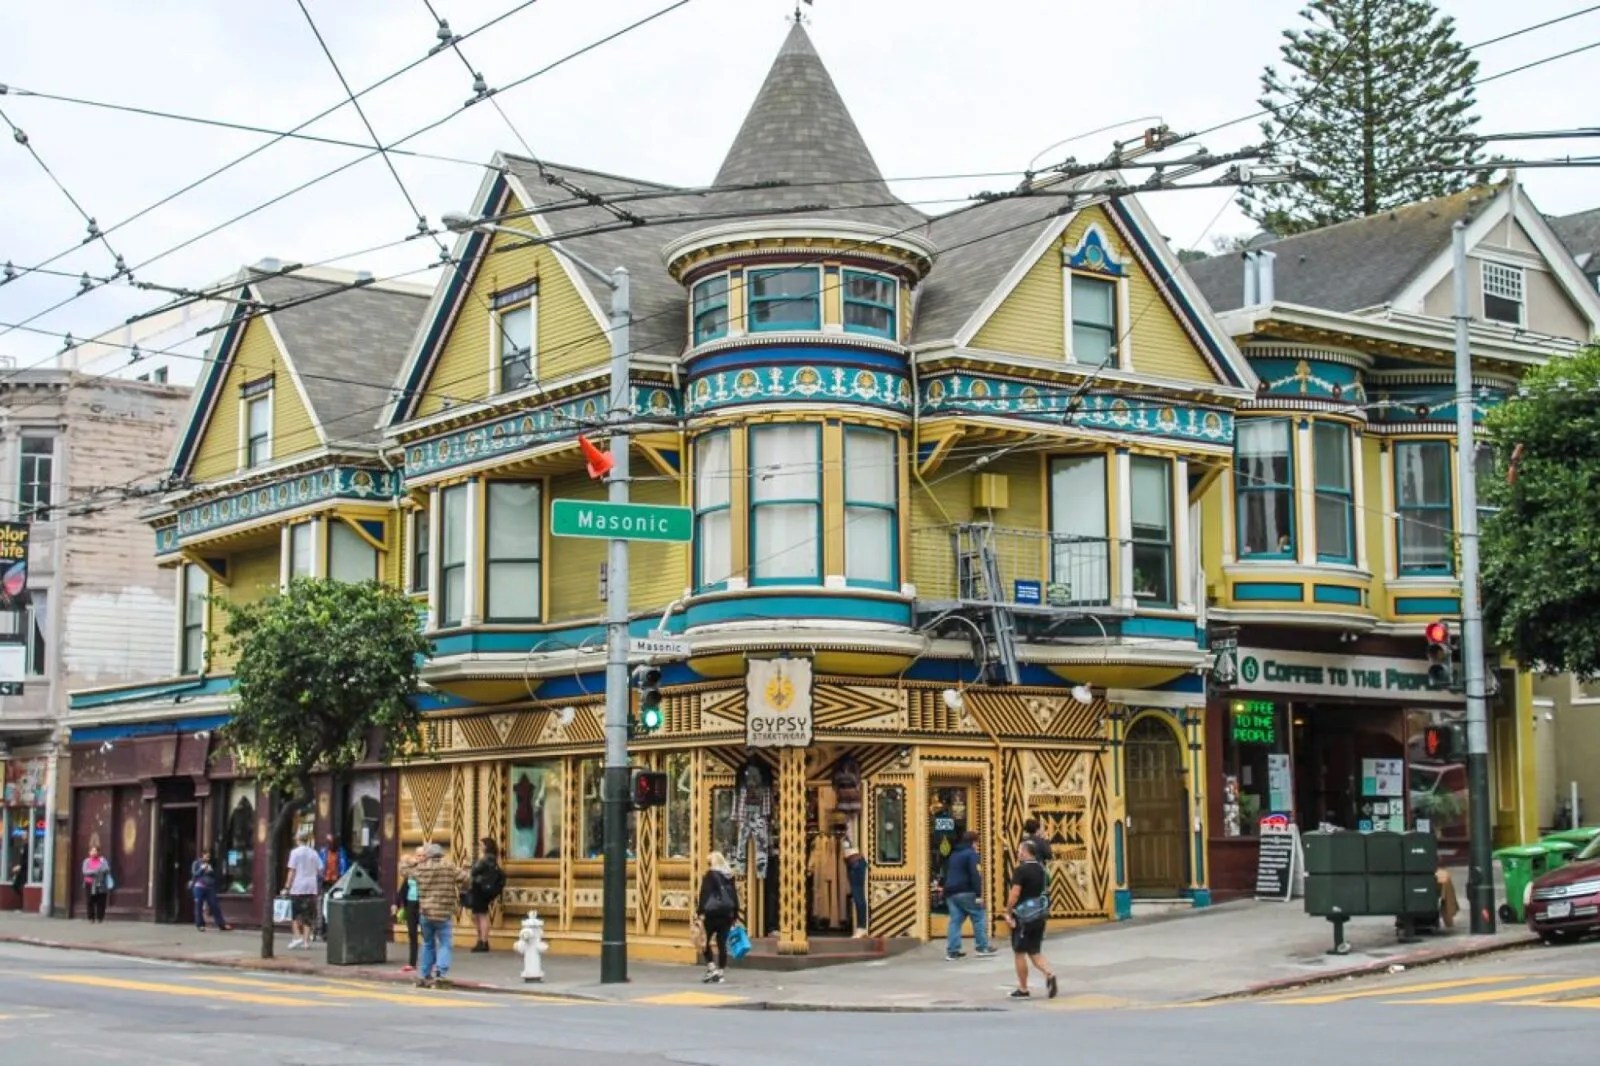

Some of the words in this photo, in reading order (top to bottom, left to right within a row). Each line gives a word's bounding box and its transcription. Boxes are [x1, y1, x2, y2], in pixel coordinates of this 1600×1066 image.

[578, 510, 669, 532] Masonic
[637, 641, 682, 653] Masonic
[1263, 660, 1323, 684] COFFEE
[1328, 667, 1348, 686] TO
[1352, 669, 1381, 689] THE
[1232, 700, 1274, 715] FFEE
[751, 716, 807, 732] GYPSY
[1233, 728, 1275, 744] PEOPLE
